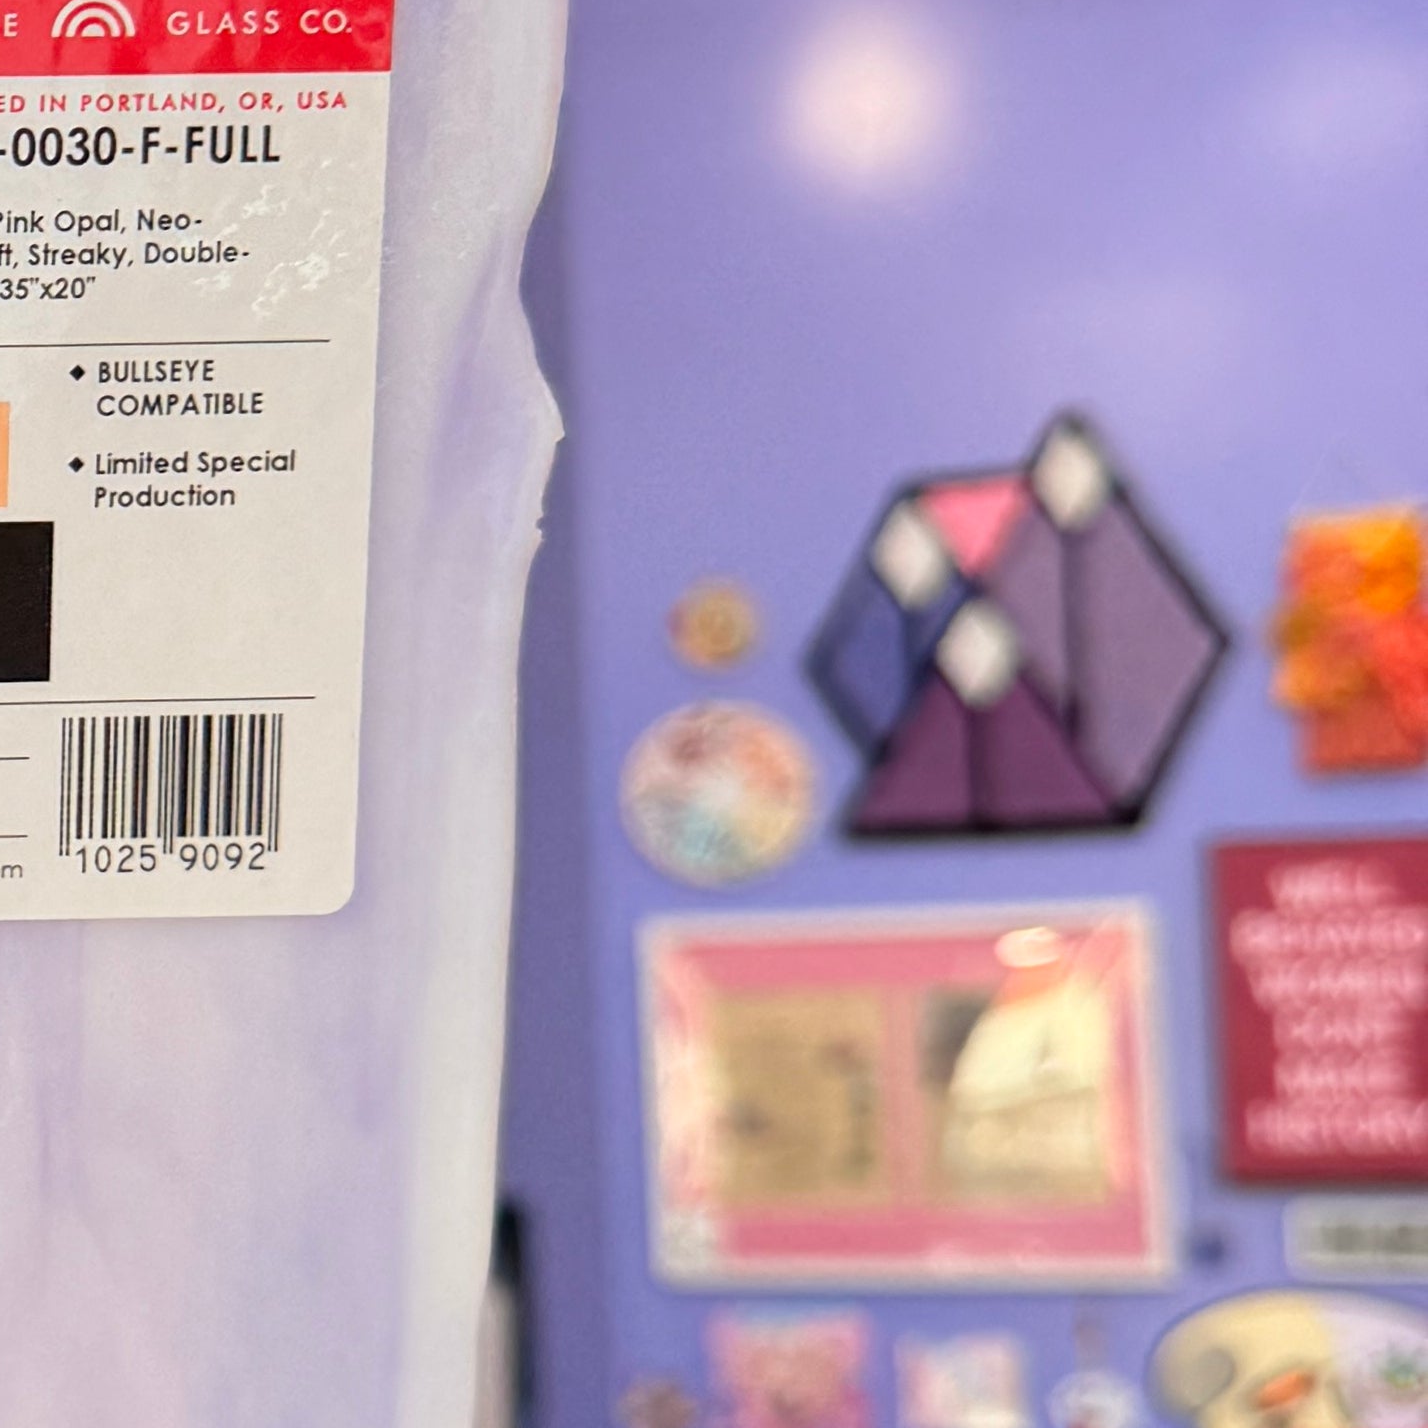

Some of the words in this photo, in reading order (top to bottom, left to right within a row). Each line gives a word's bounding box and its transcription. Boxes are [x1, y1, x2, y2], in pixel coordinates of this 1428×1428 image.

[166, 9, 280, 36] GLASS
[299, 8, 353, 35] CO.
[39, 94, 67, 113] IN
[80, 92, 225, 114] PORTLAND,
[238, 91, 283, 113] OR,
[297, 90, 347, 110] USA
[54, 208, 126, 237] Opal,
[137, 208, 203, 231] Neo-
[27, 241, 134, 270] Streaky,
[144, 240, 250, 264] Double-
[98, 359, 215, 384] BULLSEYE
[96, 392, 264, 417] COMPATIBLE
[95, 450, 189, 475] Limited
[196, 449, 296, 478] Special
[94, 484, 236, 509] Production
[76, 844, 157, 874] 1025
[179, 841, 266, 872] 9092
